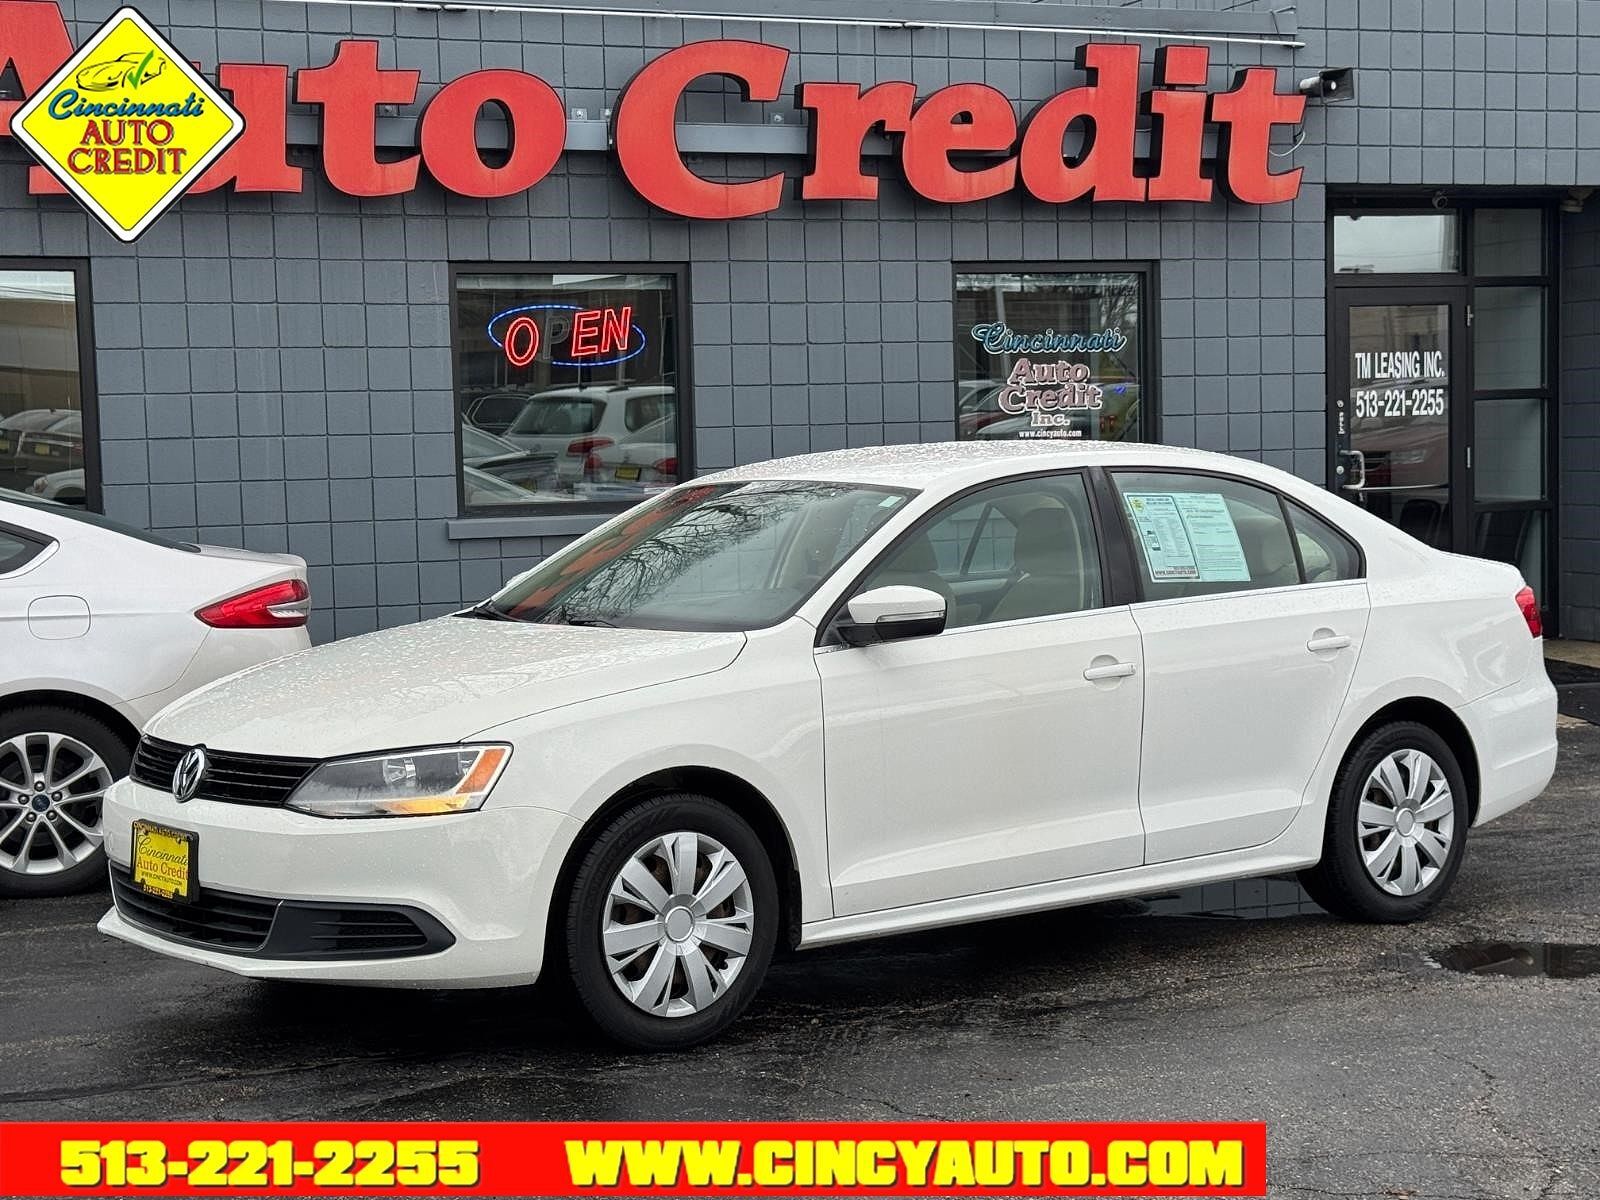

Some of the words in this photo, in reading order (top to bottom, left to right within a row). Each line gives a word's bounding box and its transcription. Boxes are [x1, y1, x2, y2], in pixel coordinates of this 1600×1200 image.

[613, 40, 1307, 219] Credit
[504, 306, 632, 367] OPEN
[971, 322, 1128, 354] Cincinnati
[1007, 357, 1091, 386] Auto
[1354, 352, 1371, 379] TM
[1374, 351, 1420, 379] LEASING
[1423, 350, 1445, 378] INC.
[998, 381, 1104, 414] Credit
[1355, 388, 1444, 418] 513-221-2255
[1018, 428, 1082, 439] www.cincyauto.com
[1031, 411, 1071, 427] Inc.
[136, 834, 190, 865] Cincinnati
[136, 855, 159, 873] Auto
[160, 861, 190, 880] Credit
